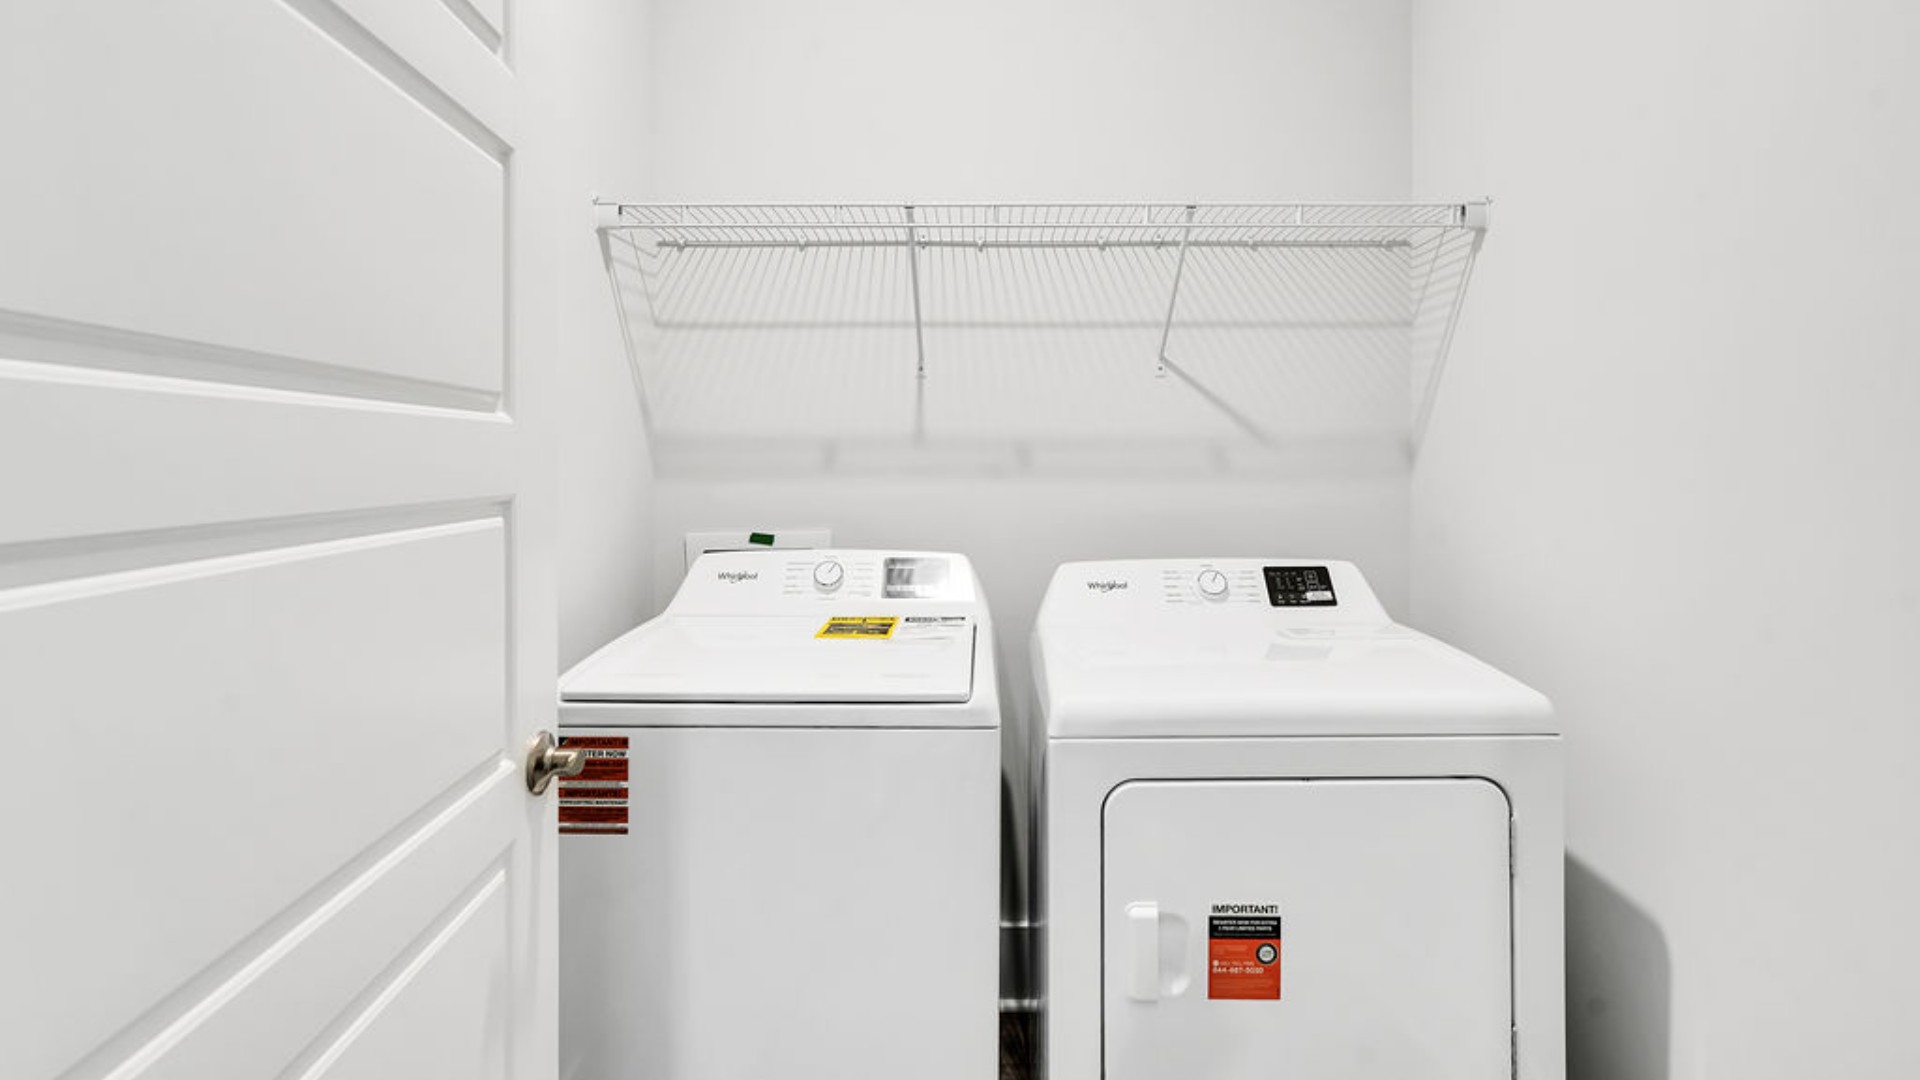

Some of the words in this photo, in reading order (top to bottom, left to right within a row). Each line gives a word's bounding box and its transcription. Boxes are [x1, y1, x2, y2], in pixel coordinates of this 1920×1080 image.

[718, 570, 758, 584] Whirlpool
[1087, 580, 1127, 593] Whirlpool
[1212, 904, 1278, 913] IMPORTANT!
